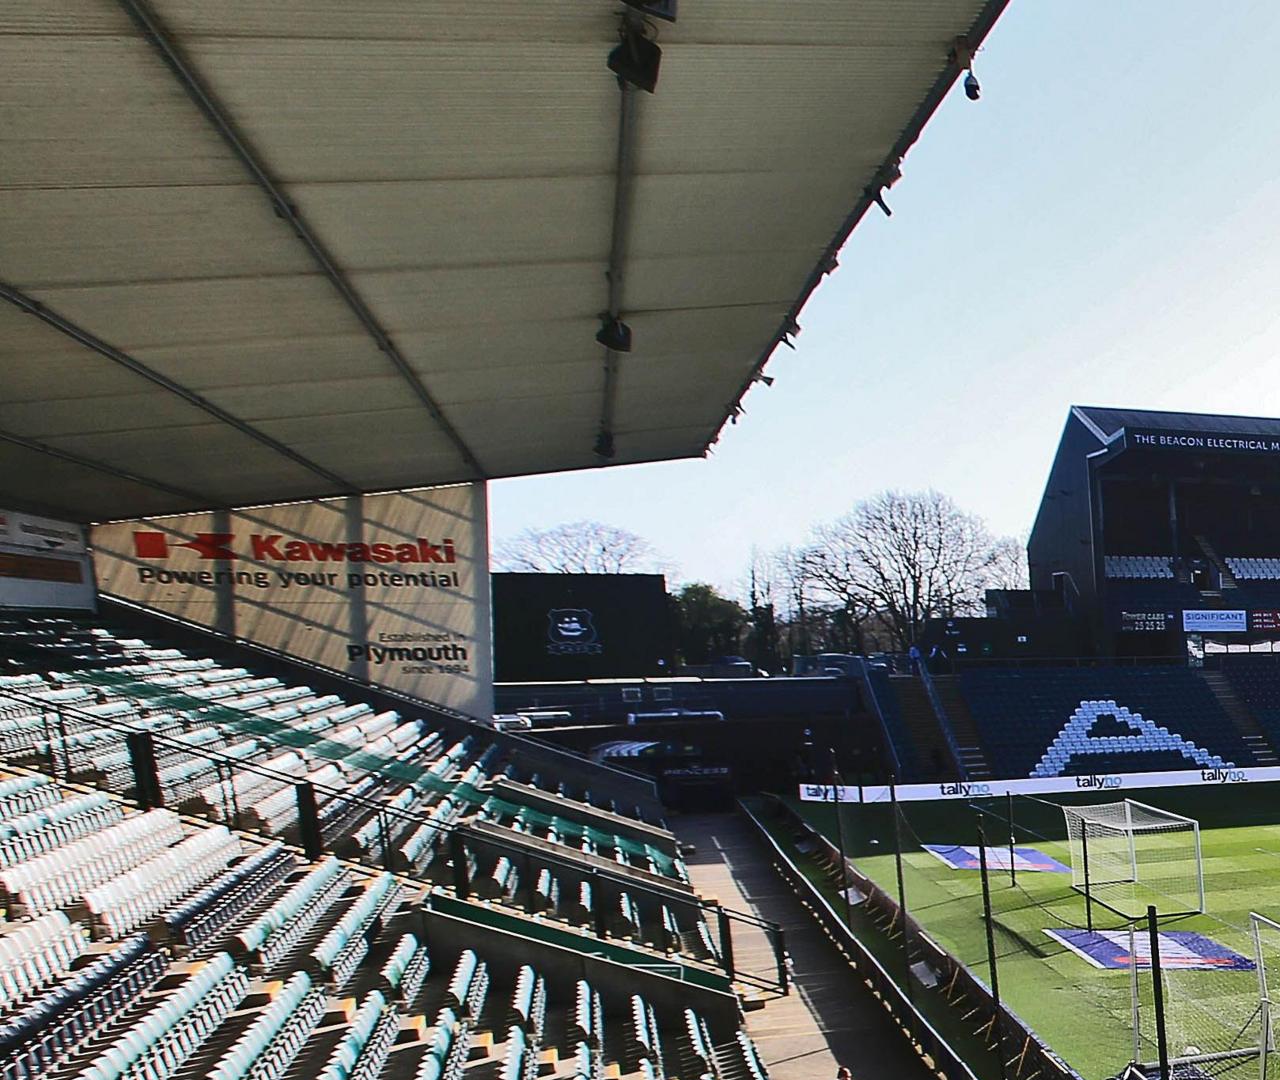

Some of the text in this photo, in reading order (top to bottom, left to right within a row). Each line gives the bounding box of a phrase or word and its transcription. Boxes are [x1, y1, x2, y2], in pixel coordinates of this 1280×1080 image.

[1134, 434, 1156, 445] THE
[1159, 436, 1204, 447] BEACON
[1207, 438, 1268, 451] ELECTRICAL
[250, 533, 456, 564] Kawasaki
[137, 566, 460, 590] Powering your potential
[1184, 612, 1244, 621] SIGNIFICANT
[1135, 621, 1145, 630] 25
[1145, 621, 1155, 630] 25
[1156, 621, 1166, 630] 25
[378, 632, 450, 643] Established
[346, 643, 468, 665] Plymouth
[1201, 769, 1246, 782] tallyho
[1075, 776, 1122, 789] tallyho
[939, 783, 992, 797] tallyho
